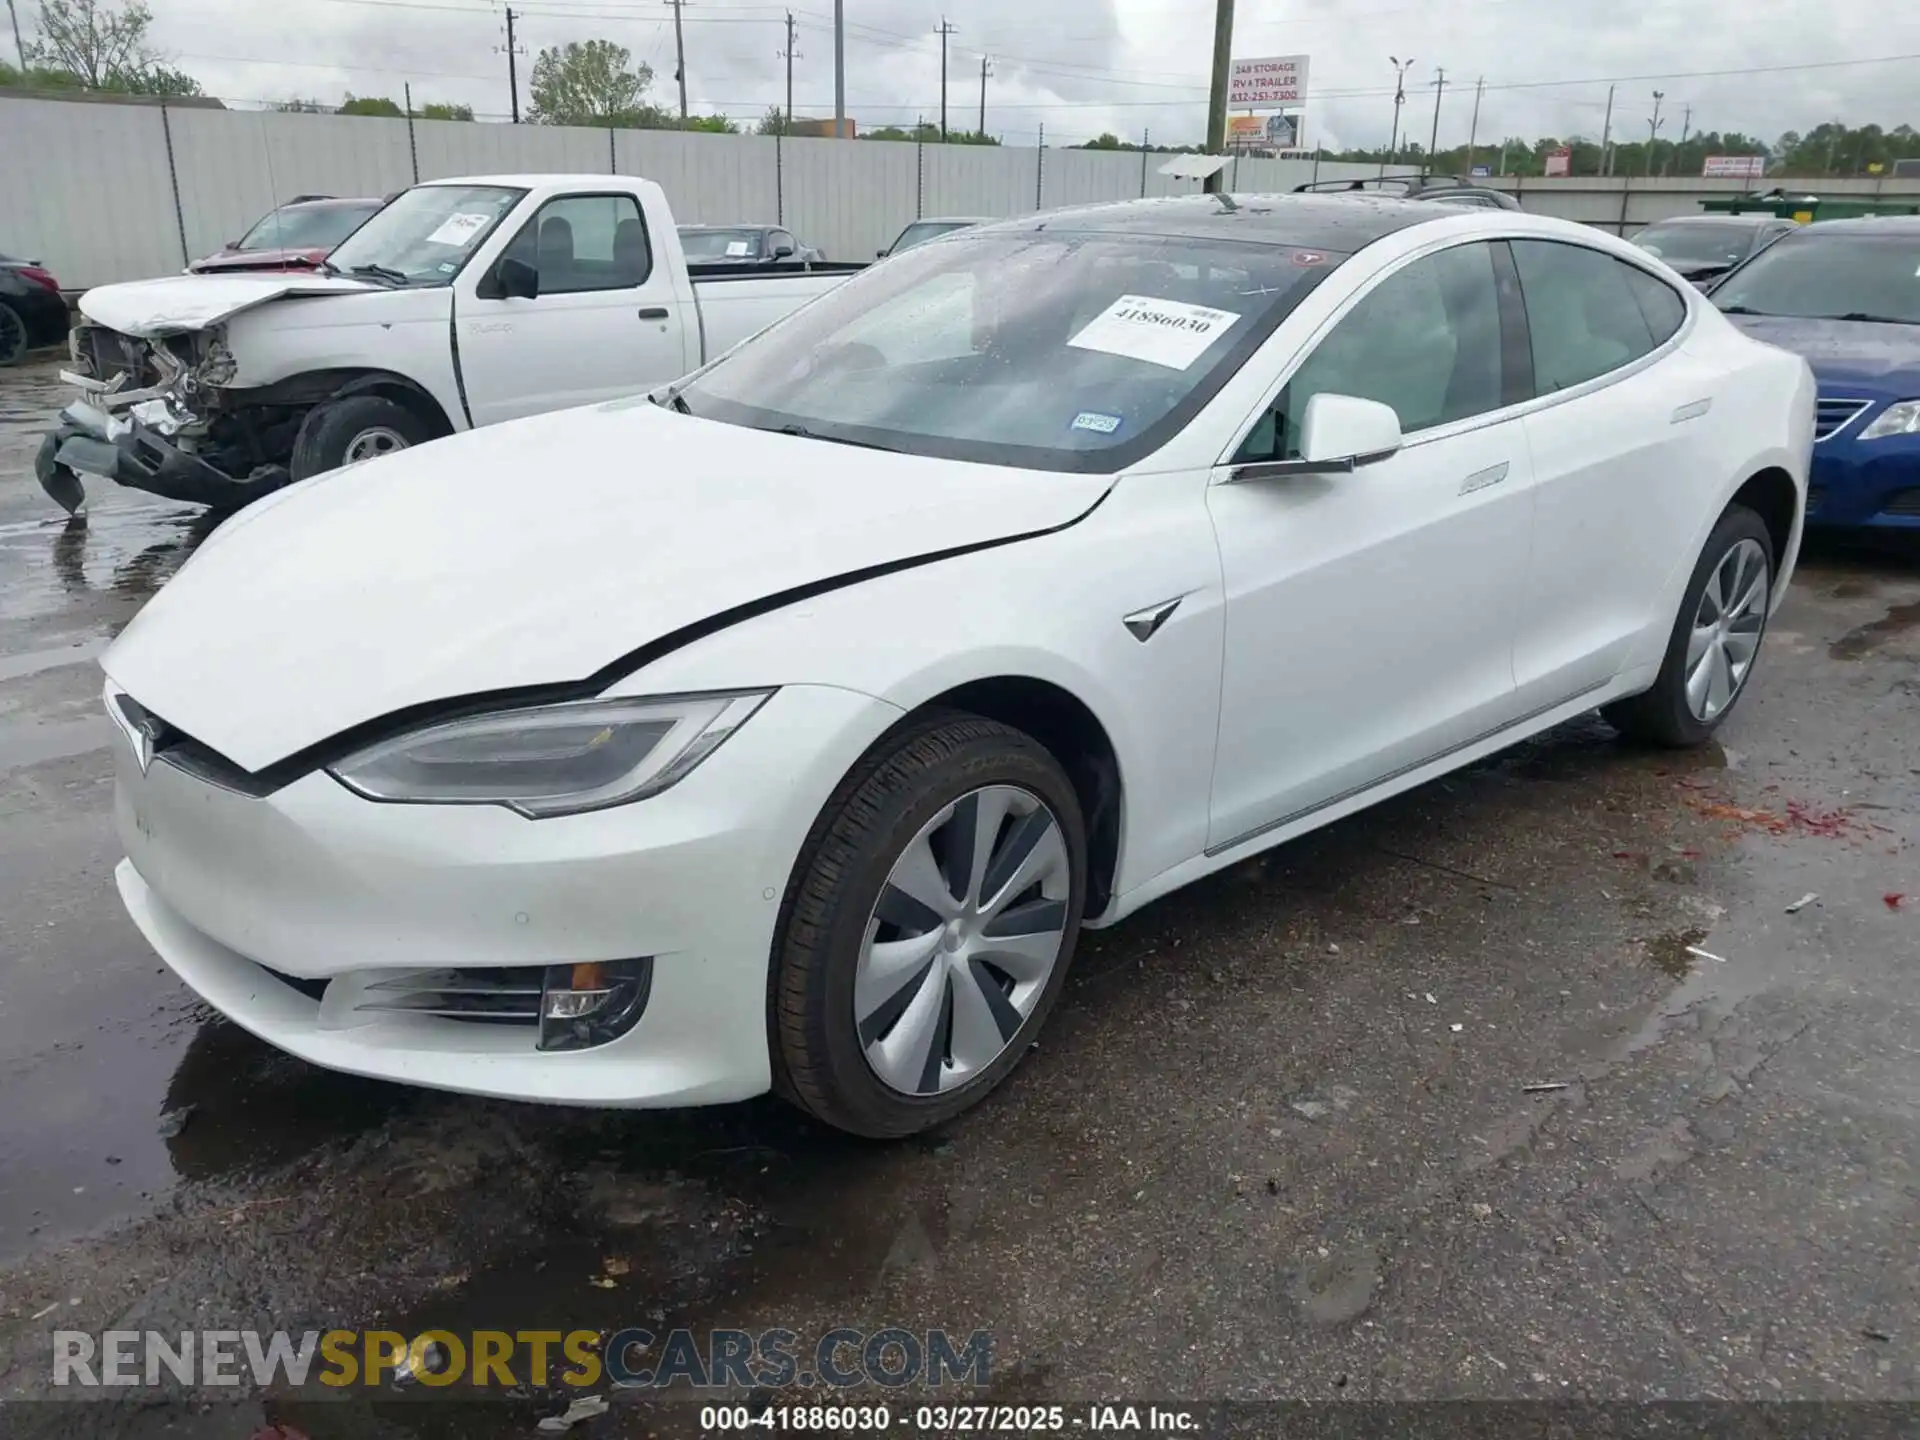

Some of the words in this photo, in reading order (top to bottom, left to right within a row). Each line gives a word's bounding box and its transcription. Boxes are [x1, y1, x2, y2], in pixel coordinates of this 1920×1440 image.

[1254, 63, 1297, 73] STORAGE
[1233, 80, 1246, 88] RV
[1254, 76, 1297, 88] TRAILER
[1115, 308, 1211, 333] 41886030
